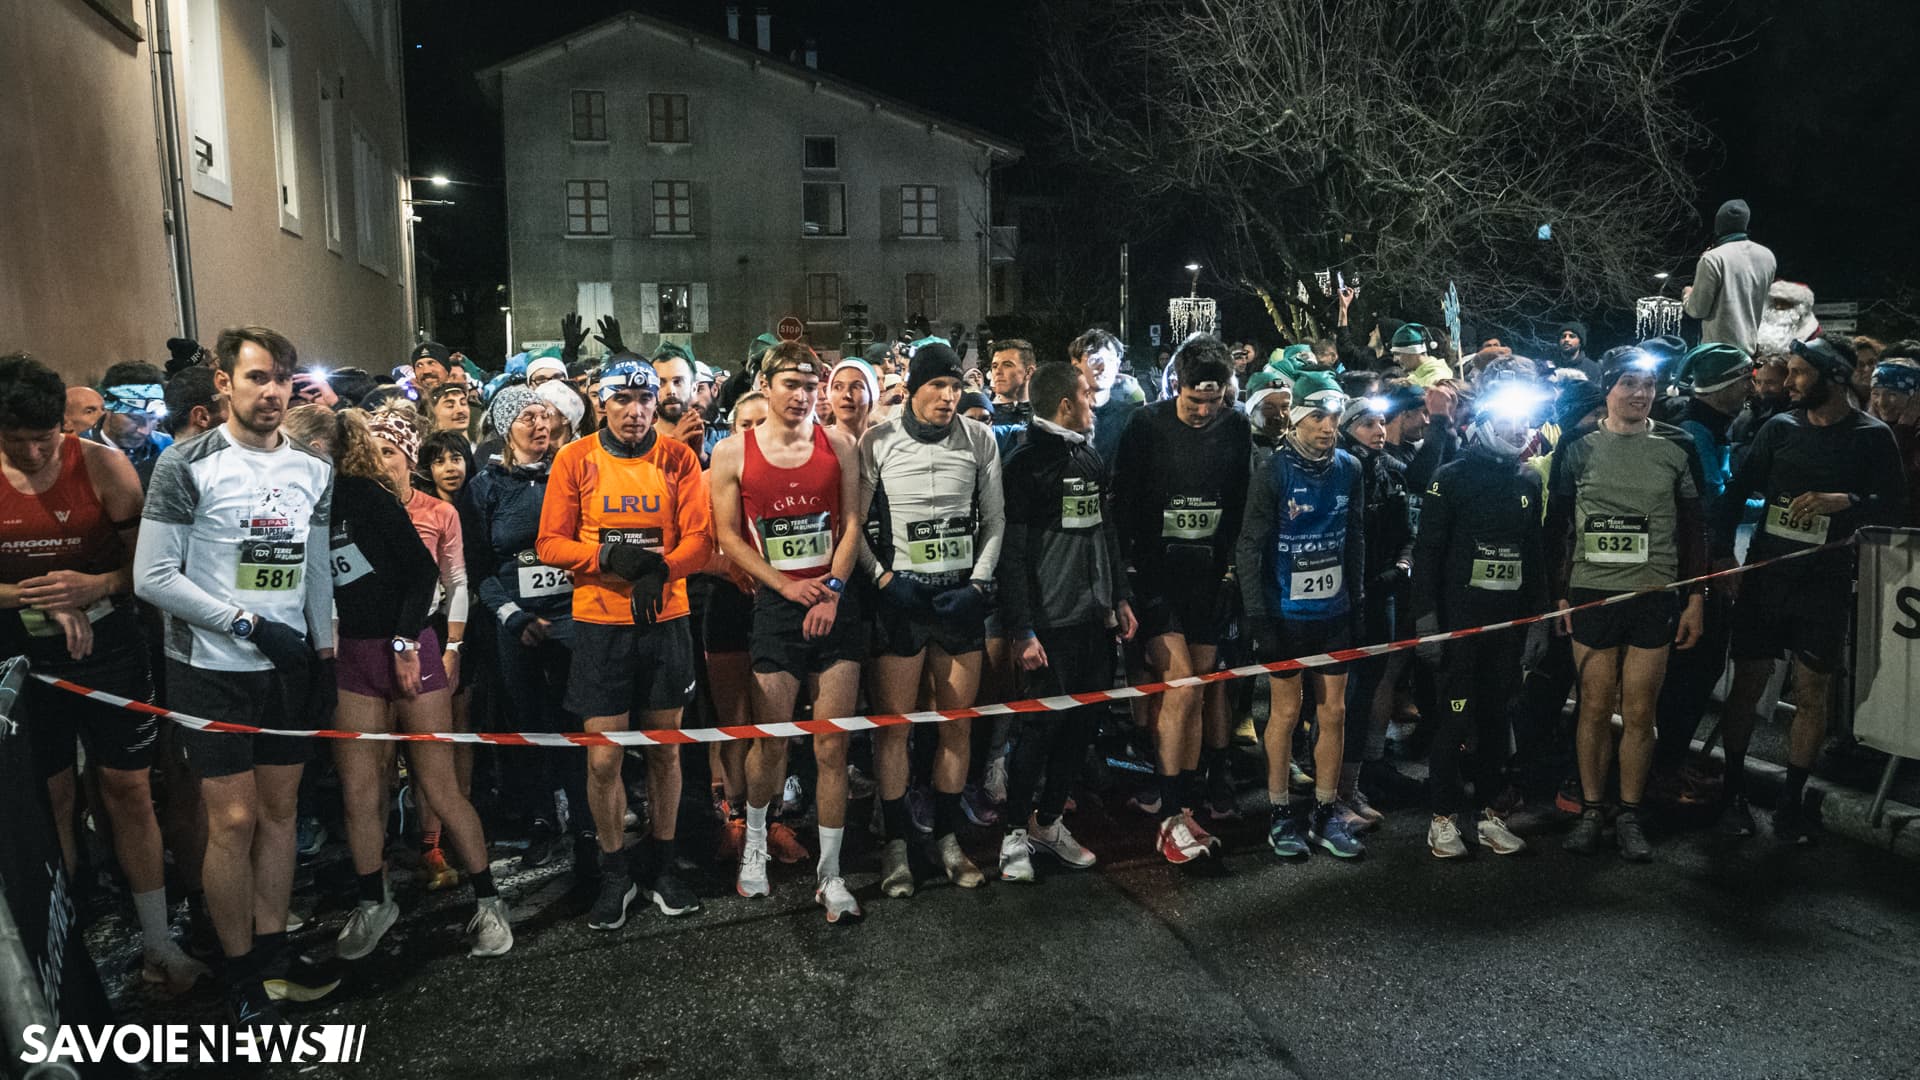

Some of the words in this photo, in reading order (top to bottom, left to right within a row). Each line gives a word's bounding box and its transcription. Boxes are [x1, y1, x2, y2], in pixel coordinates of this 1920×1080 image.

[781, 325, 800, 334] STOP
[603, 495, 660, 513] LRU
[1077, 499, 1099, 516] 562
[259, 519, 288, 527] SPAR
[774, 524, 788, 532] TDR
[1177, 513, 1209, 529] 639
[917, 527, 931, 535] TDR
[1, 538, 62, 548] ARGON
[782, 537, 819, 557] 621
[924, 541, 960, 560] 593
[1598, 536, 1633, 552] 632
[255, 549, 270, 558] TDR
[255, 569, 295, 588] 581
[532, 569, 568, 589] 232
[1485, 563, 1514, 579] 529
[1303, 574, 1334, 593] 219
[1892, 586, 1920, 639] S
